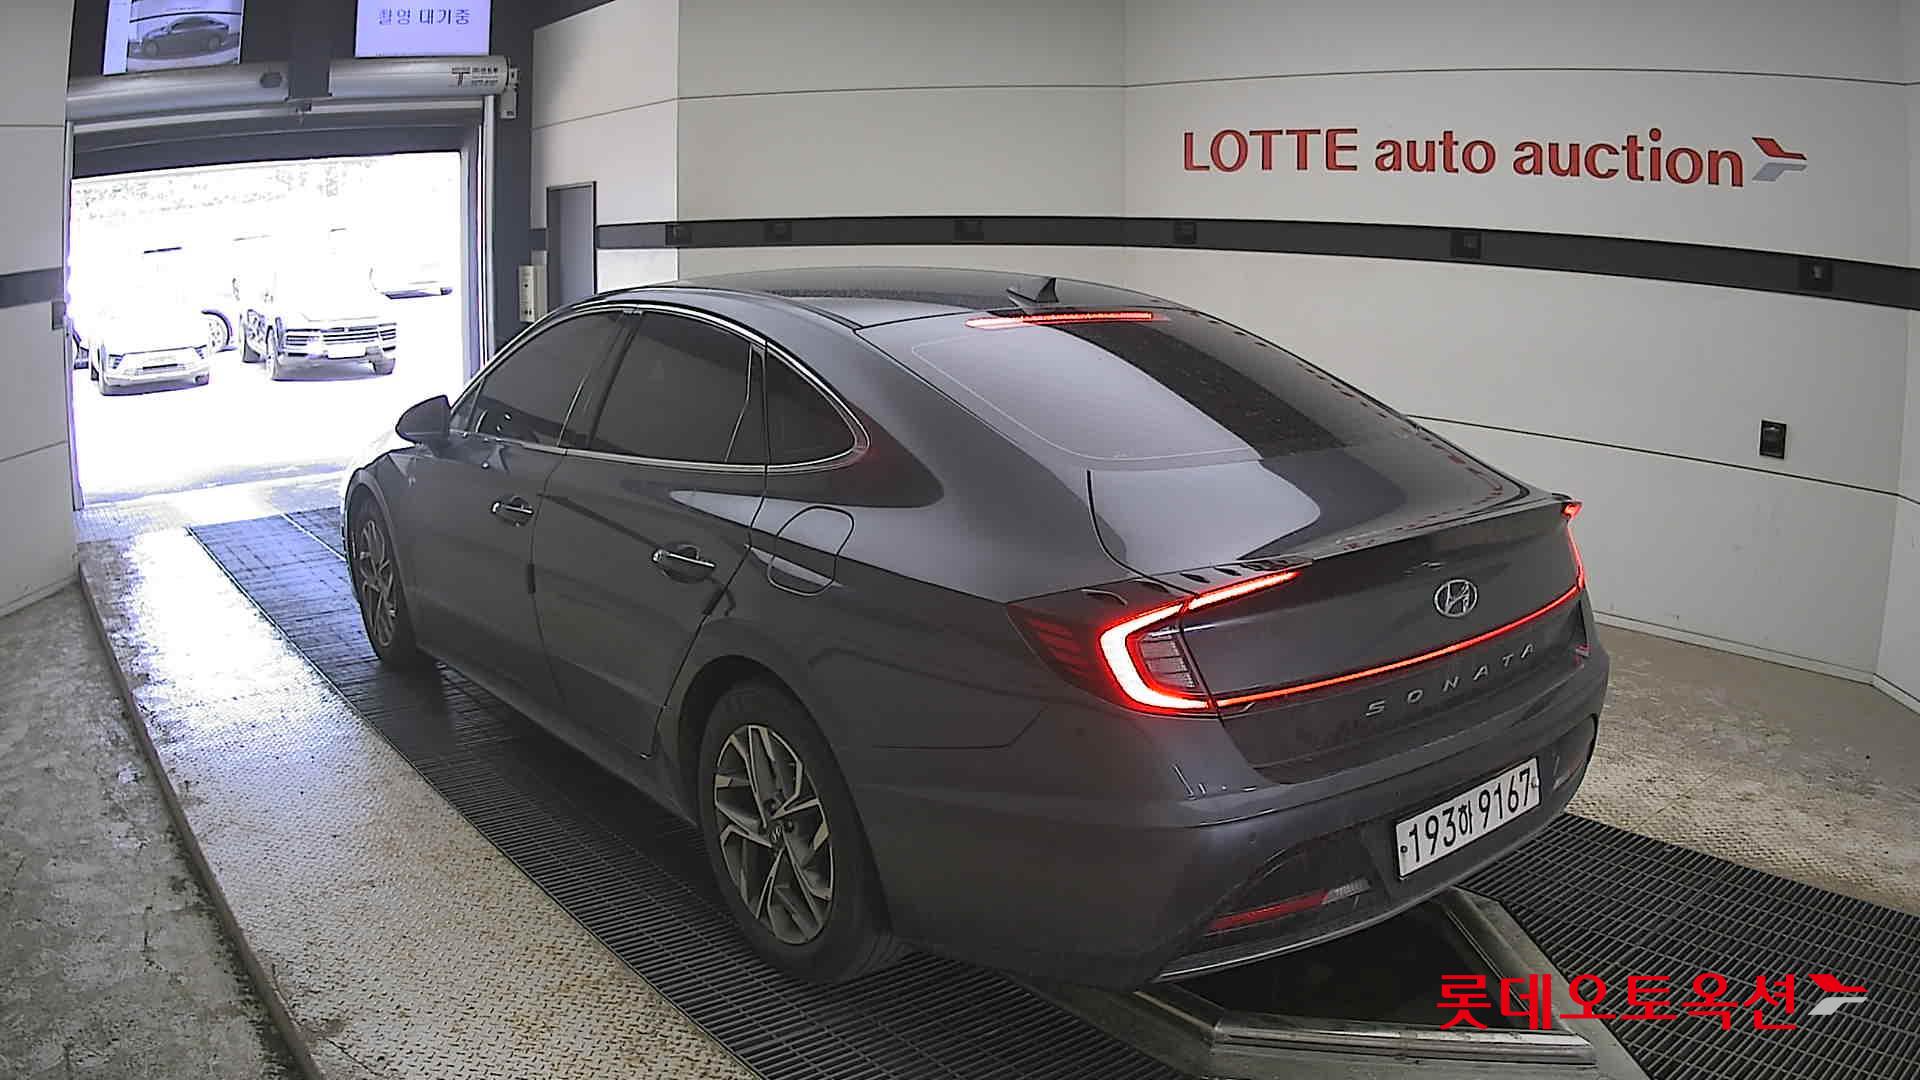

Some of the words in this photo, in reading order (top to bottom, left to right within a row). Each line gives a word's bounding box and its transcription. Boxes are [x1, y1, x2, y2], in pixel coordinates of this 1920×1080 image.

[419, 8, 471, 25] 대기중
[1183, 128, 1358, 173] LOTTE
[1375, 130, 1497, 175] auto
[1512, 128, 1745, 188] auction
[1365, 643, 1534, 716] SONATA
